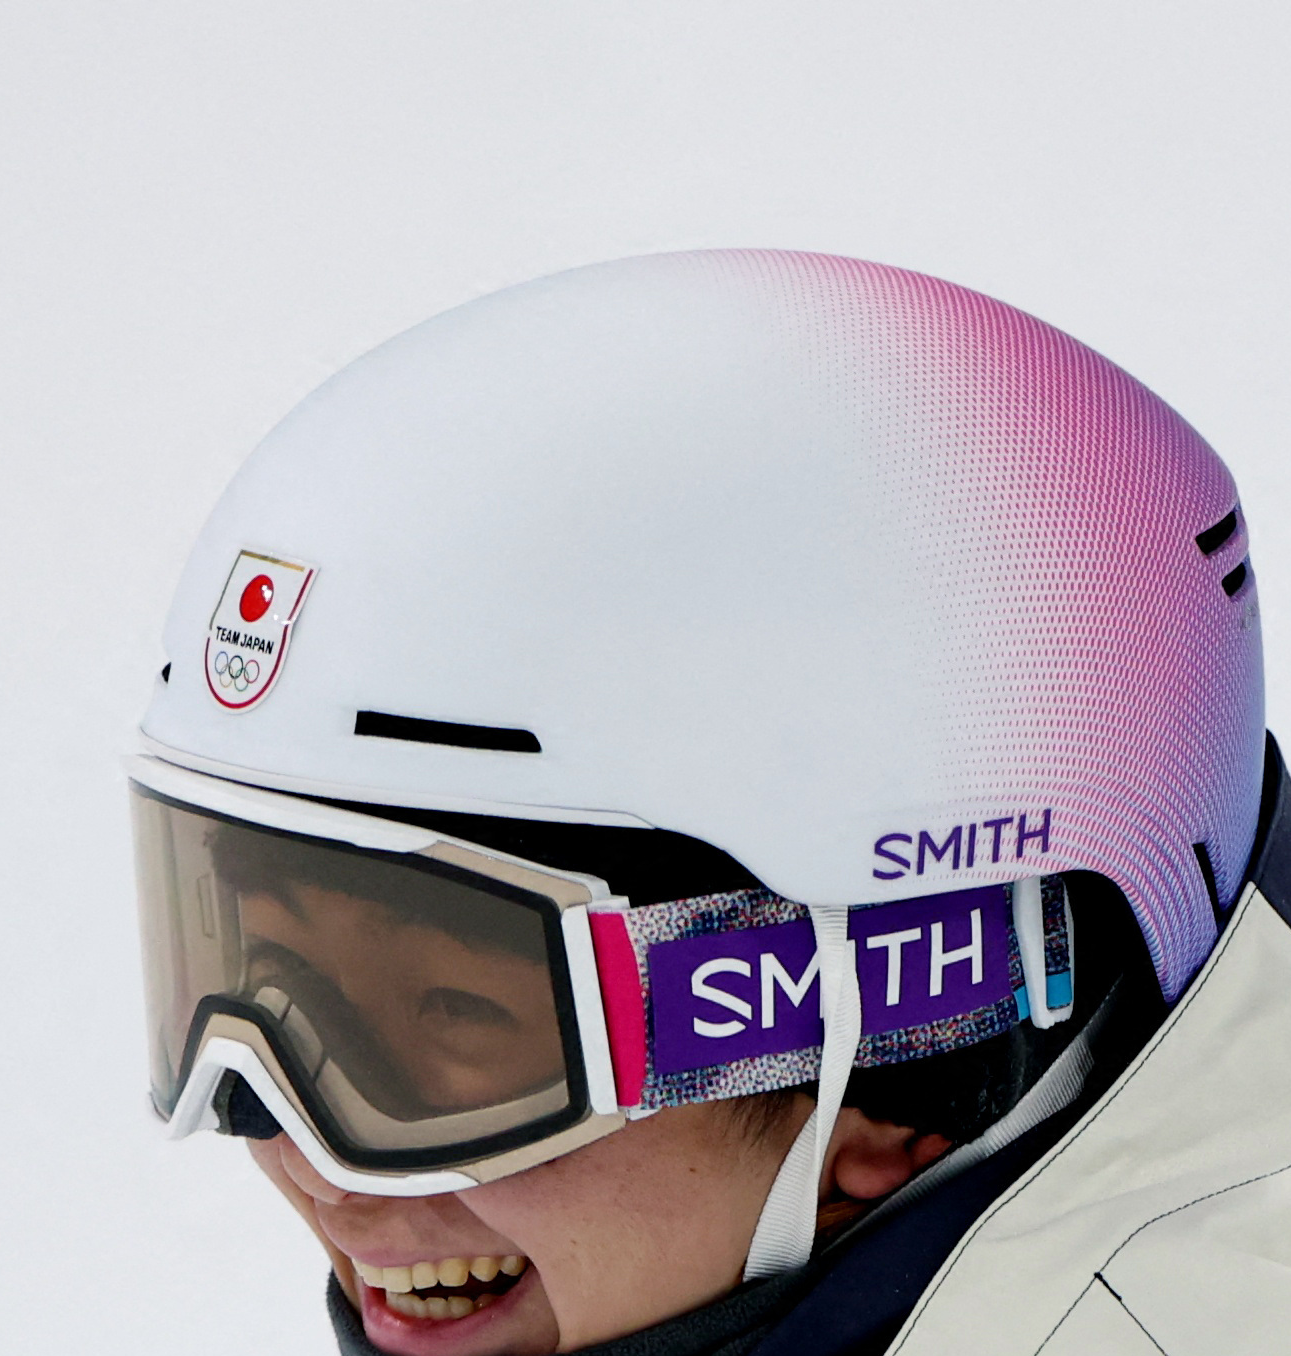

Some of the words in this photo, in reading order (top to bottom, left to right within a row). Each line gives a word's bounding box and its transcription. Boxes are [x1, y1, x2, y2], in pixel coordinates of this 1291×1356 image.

[216, 626, 240, 646] TEAM
[240, 633, 274, 655] JAPAN
[872, 808, 1052, 880] SMITH
[691, 908, 984, 1038] SMTH
